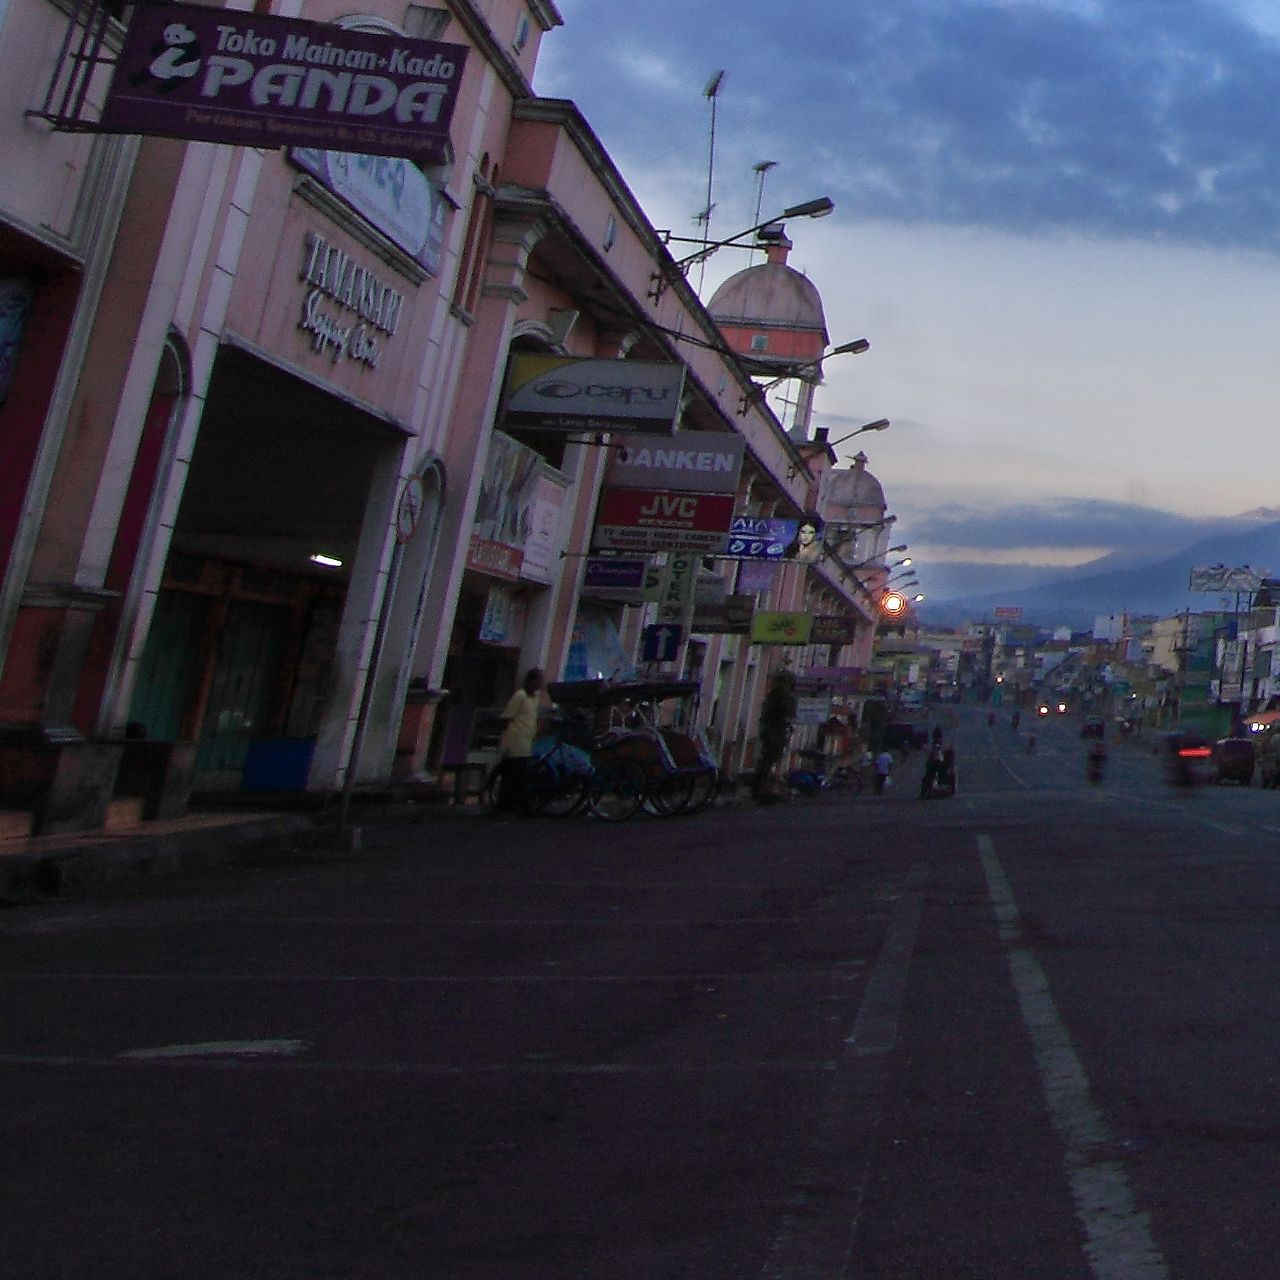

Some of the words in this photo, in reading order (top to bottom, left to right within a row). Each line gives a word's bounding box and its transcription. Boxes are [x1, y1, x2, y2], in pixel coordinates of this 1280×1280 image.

[217, 24, 278, 57] Toko
[200, 55, 449, 124] PANDA
[302, 232, 405, 336] TAMANSARI
[616, 447, 736, 471] SANKEN
[639, 495, 699, 518] JVC
